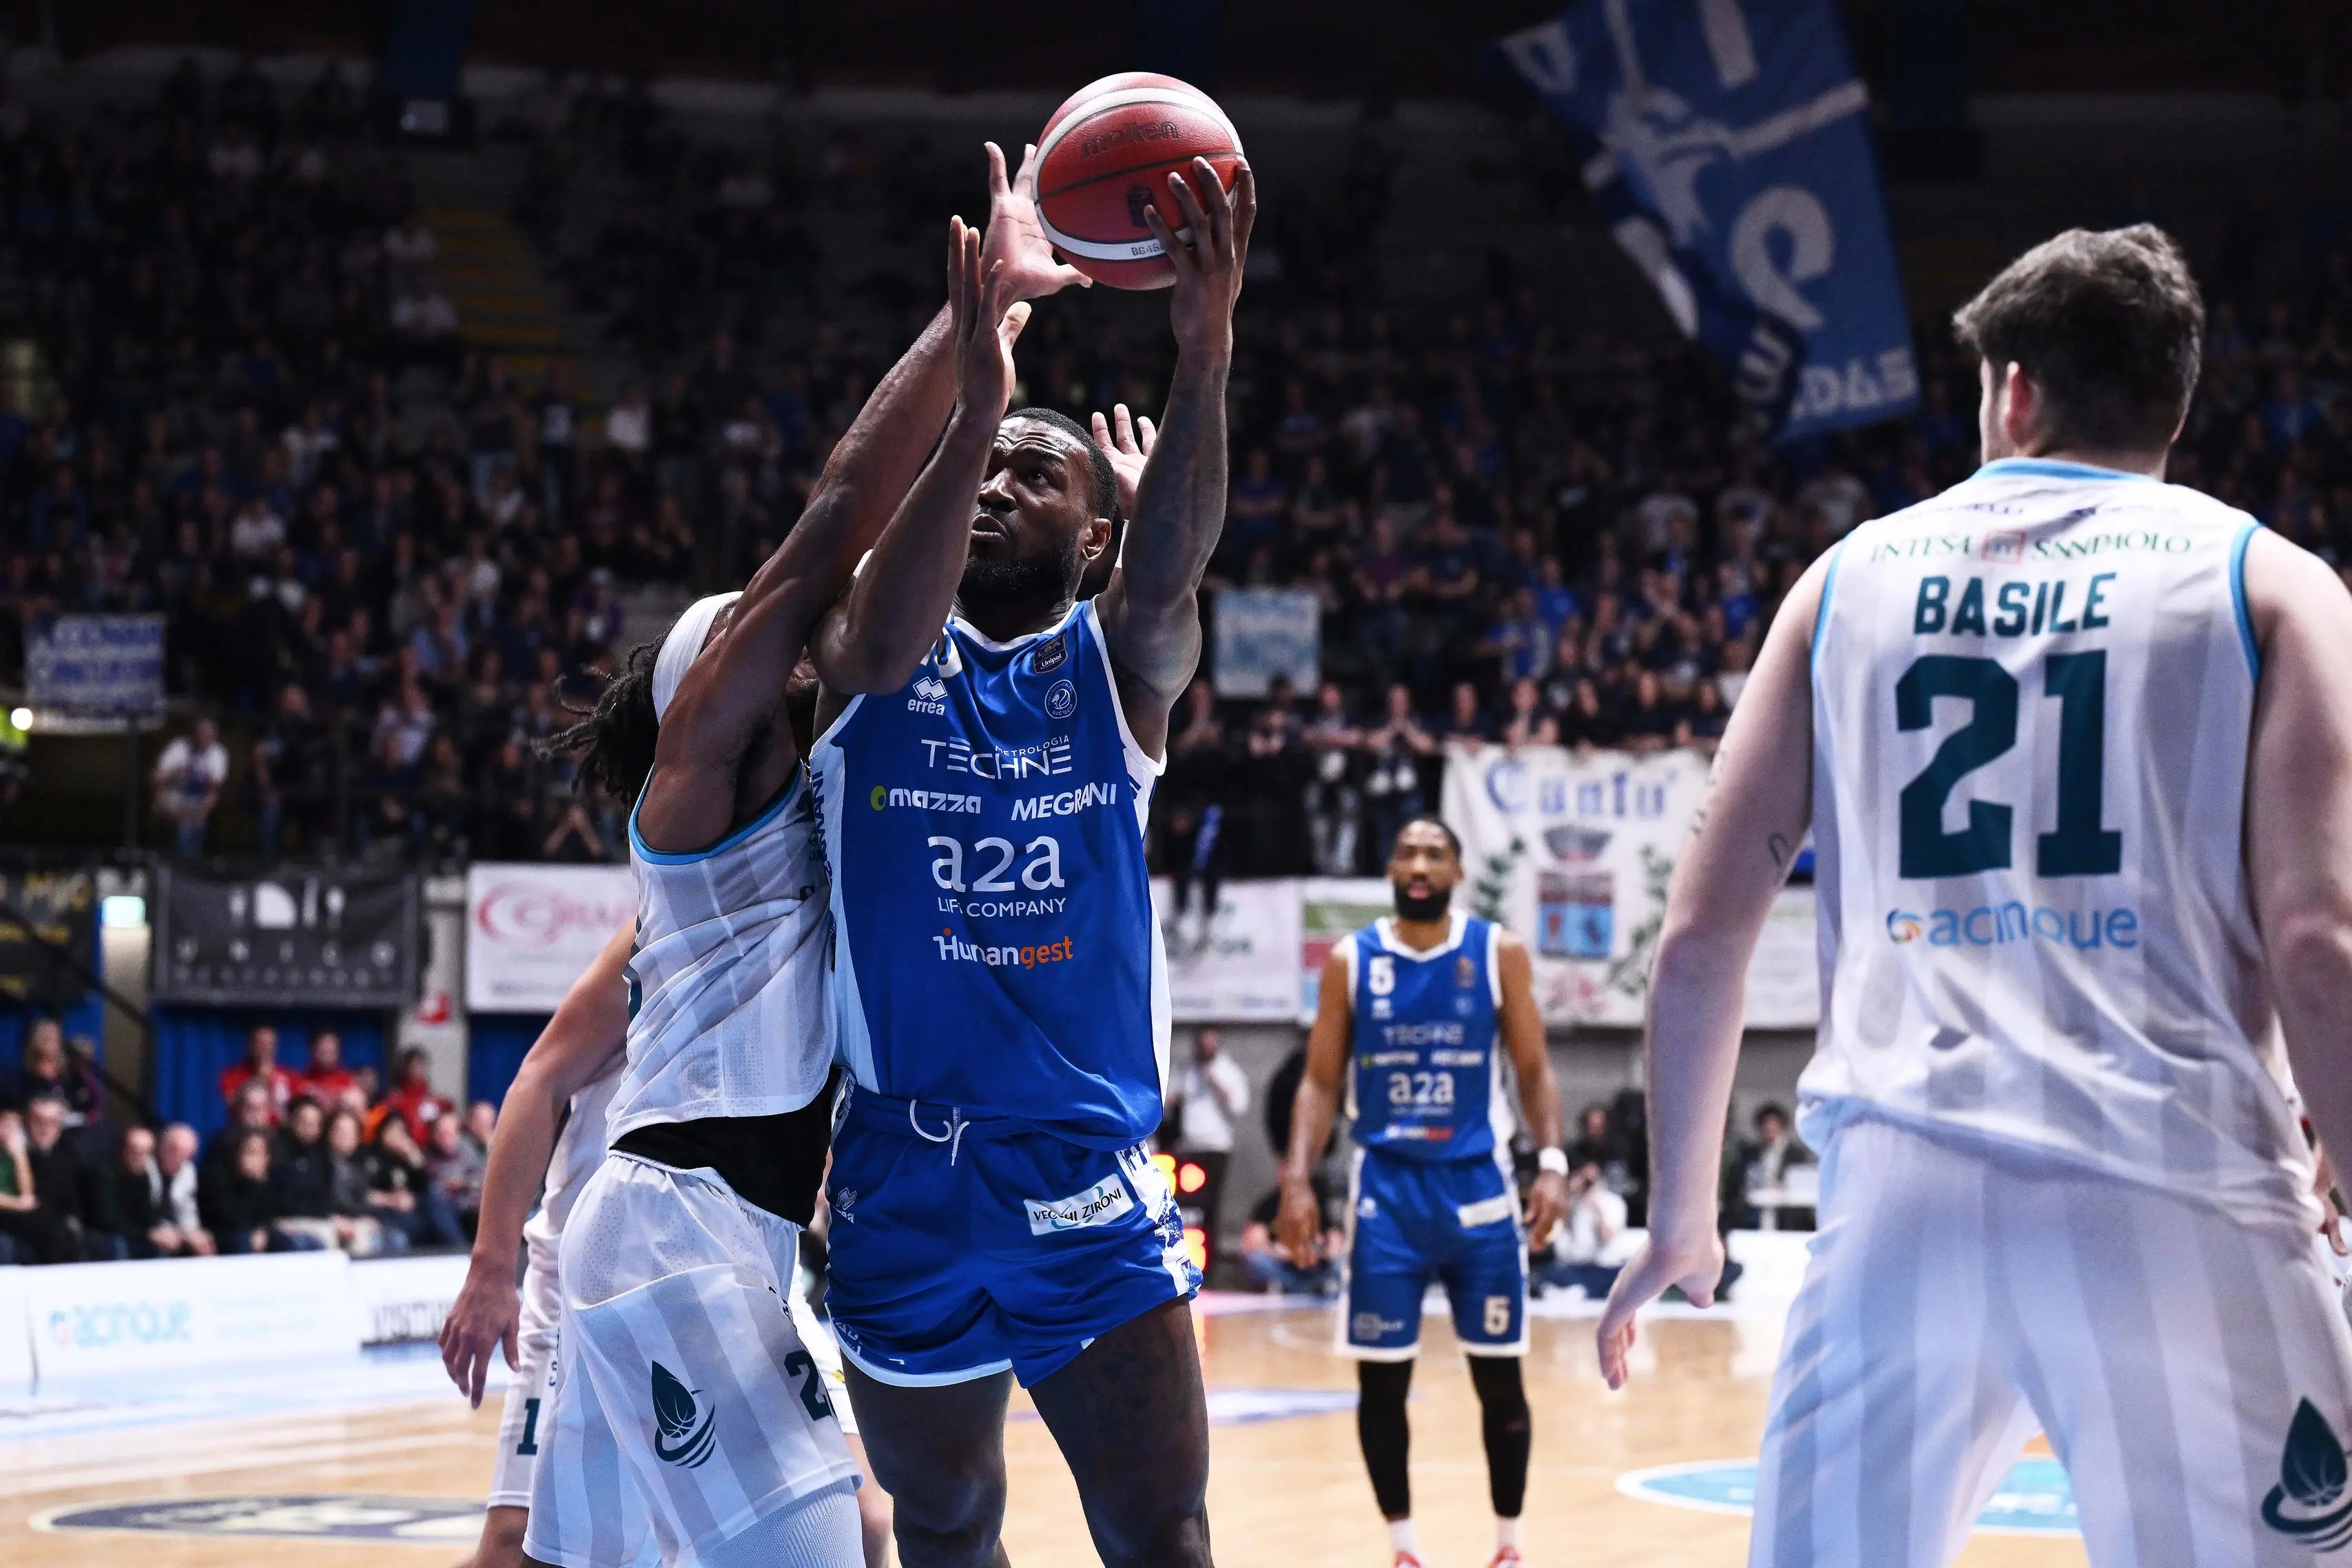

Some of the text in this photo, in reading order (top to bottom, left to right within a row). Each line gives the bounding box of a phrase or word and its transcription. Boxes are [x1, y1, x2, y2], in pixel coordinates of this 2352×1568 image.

[1082, 121, 1179, 160] molten
[1913, 571, 2117, 638] BASILE
[1041, 652, 1062, 668] Unipol
[995, 734, 1070, 756] METROLOGIA
[1895, 648, 2123, 880] 21
[927, 835, 1065, 893] a2a
[938, 897, 1066, 918] LIF COMPANY
[1369, 956, 1396, 996] 5
[1388, 1072, 1455, 1104] a2a
[1082, 1188, 1122, 1219] ZIRONI
[1484, 1295, 1510, 1337] 5
[784, 1350, 836, 1421] 2
[517, 1398, 540, 1455] 1
